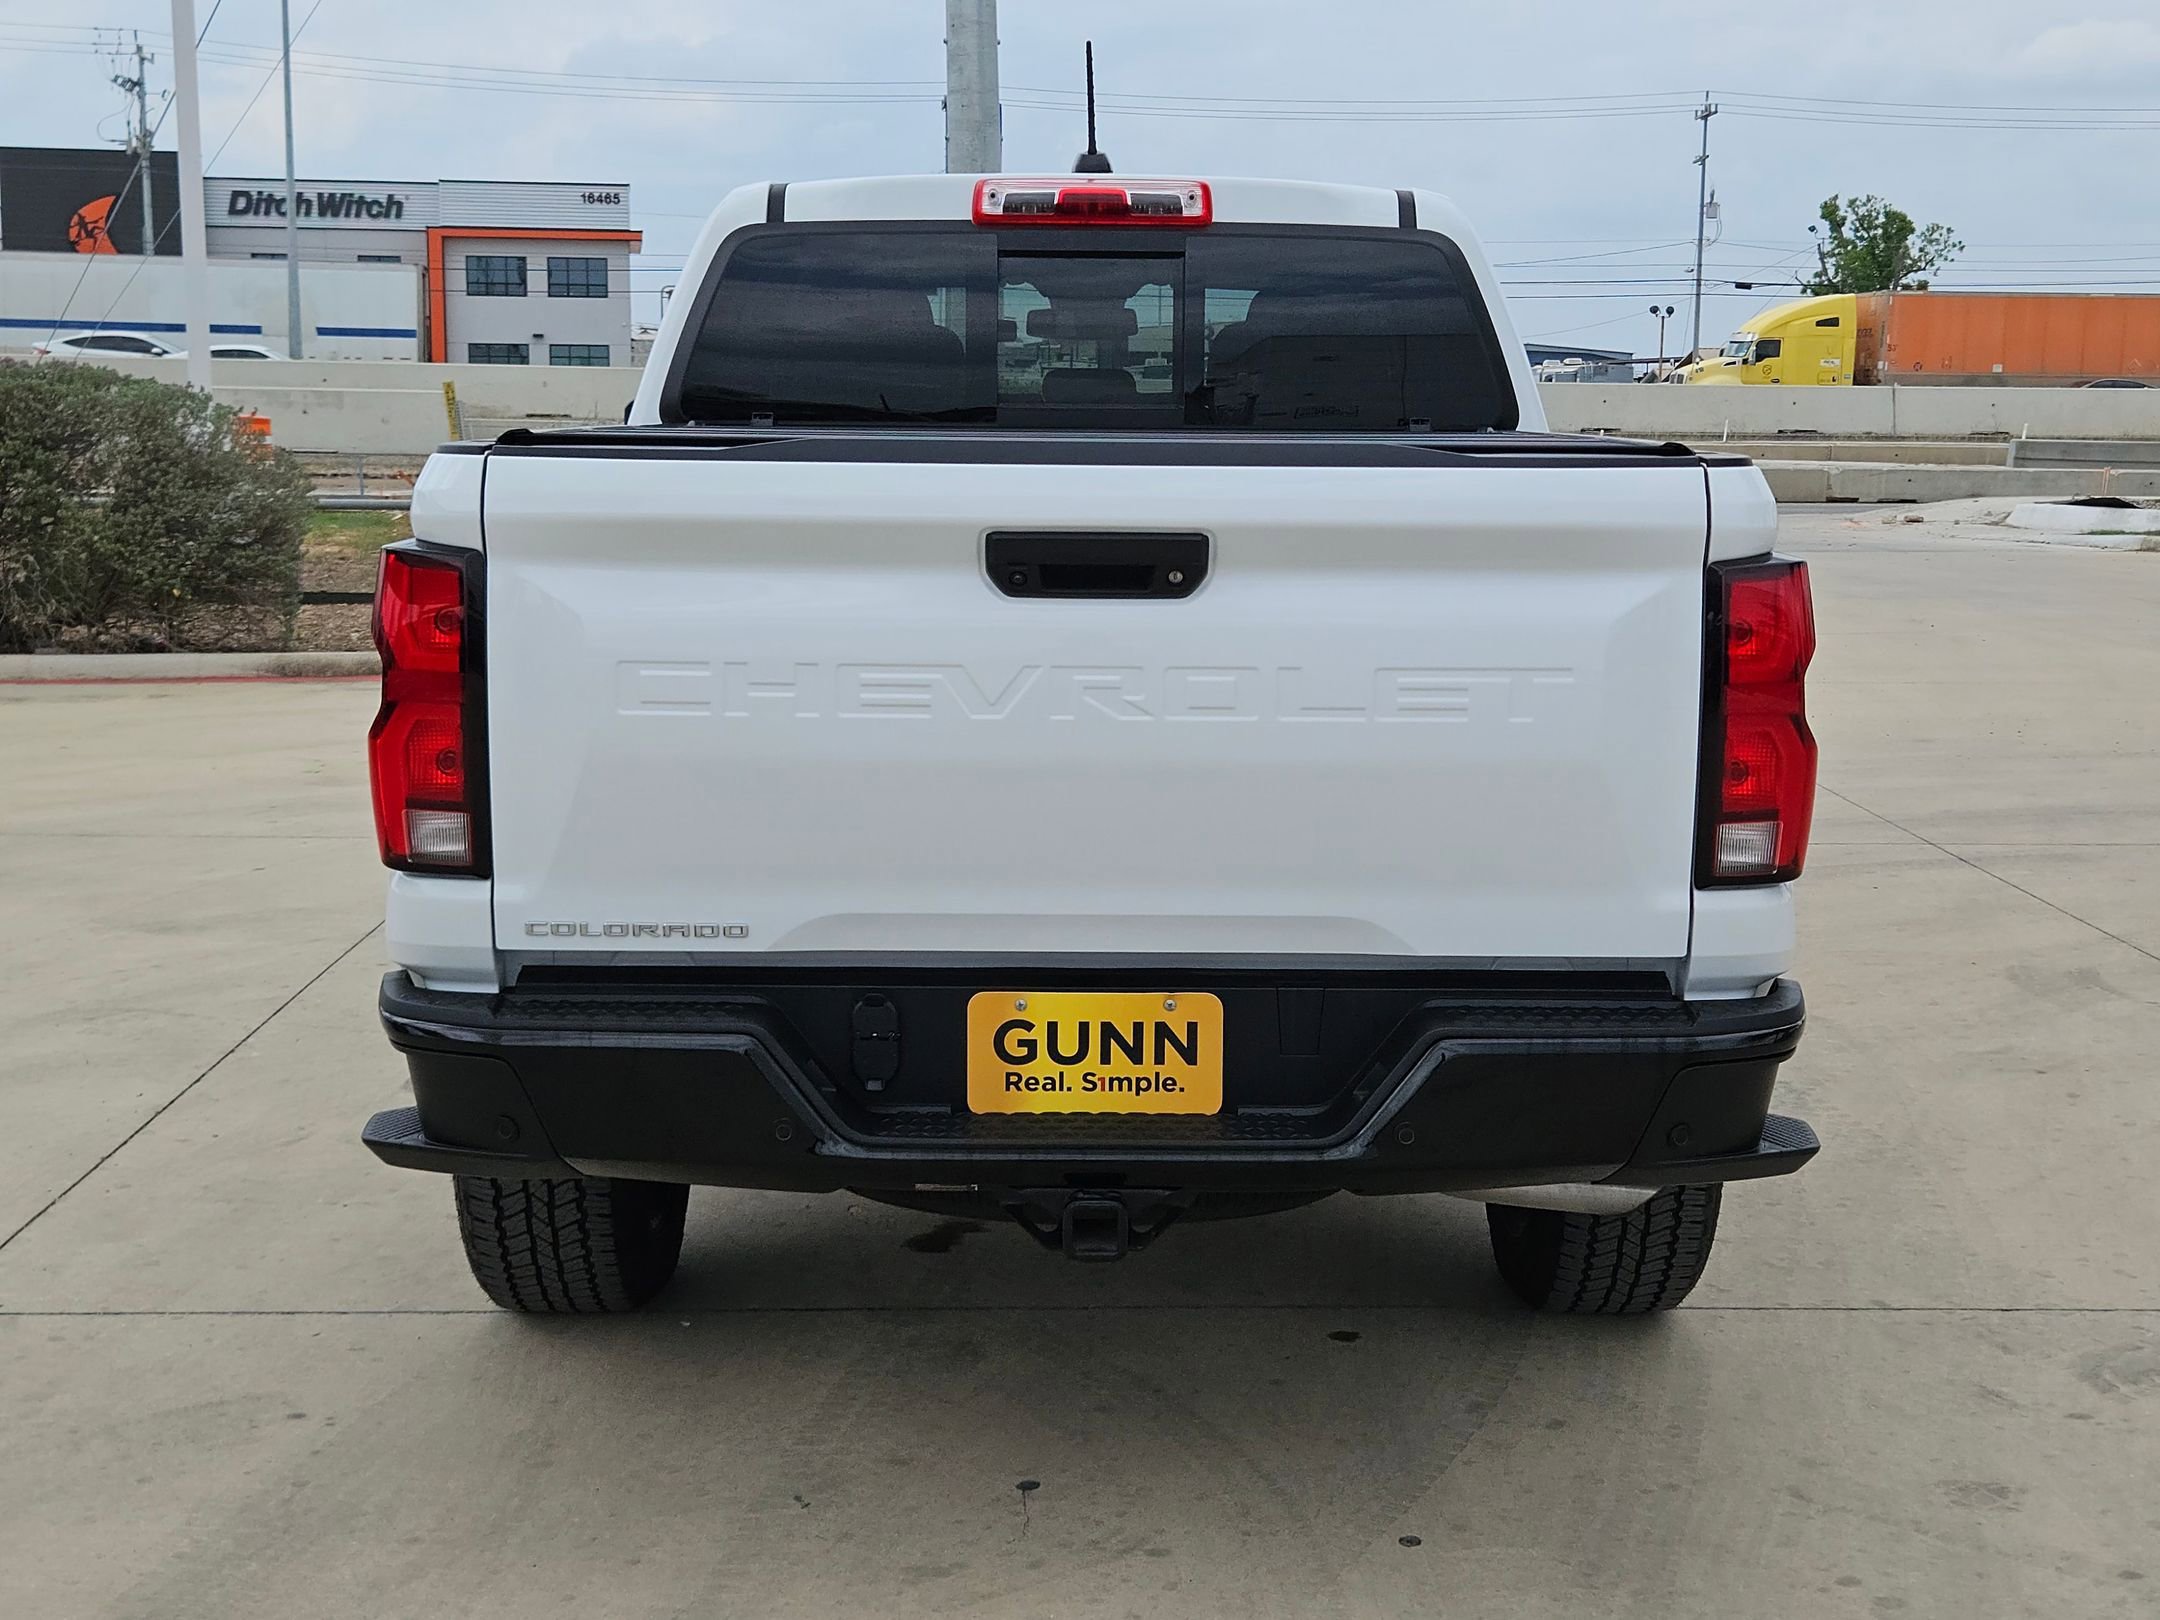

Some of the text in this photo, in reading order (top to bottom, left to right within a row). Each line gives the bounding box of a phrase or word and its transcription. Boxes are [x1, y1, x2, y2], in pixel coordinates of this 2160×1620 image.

[228, 190, 404, 219] Ditch Witch
[615, 660, 1575, 722] CHEVROLET
[525, 920, 749, 938] COLORADO
[993, 1019, 1199, 1066] GUNN
[1005, 1071, 1072, 1092] Real.
